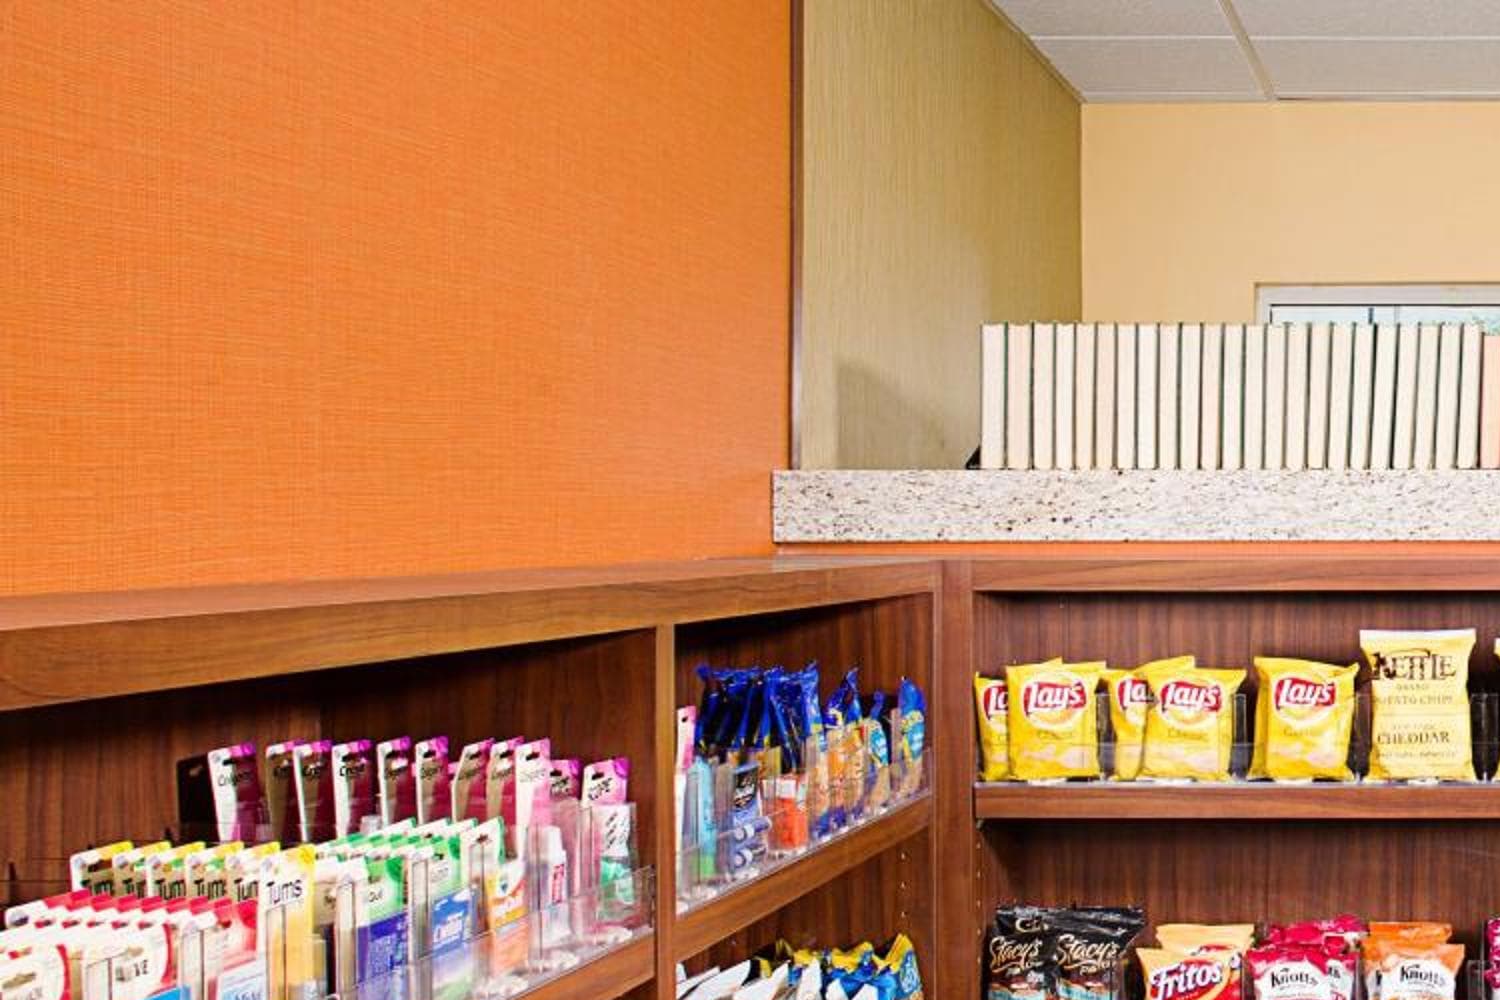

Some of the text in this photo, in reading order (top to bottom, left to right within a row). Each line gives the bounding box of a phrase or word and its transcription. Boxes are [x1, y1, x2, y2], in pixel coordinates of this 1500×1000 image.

[1371, 650, 1457, 681] KETTLE
[1027, 683, 1084, 712] Lay's
[1161, 682, 1220, 711] Lay's
[1277, 679, 1334, 709] Lay's
[1377, 731, 1451, 746] CHEDDAR
[266, 880, 303, 904] Tums
[990, 936, 1043, 970] Stacy's
[1056, 934, 1120, 969] Stacy's
